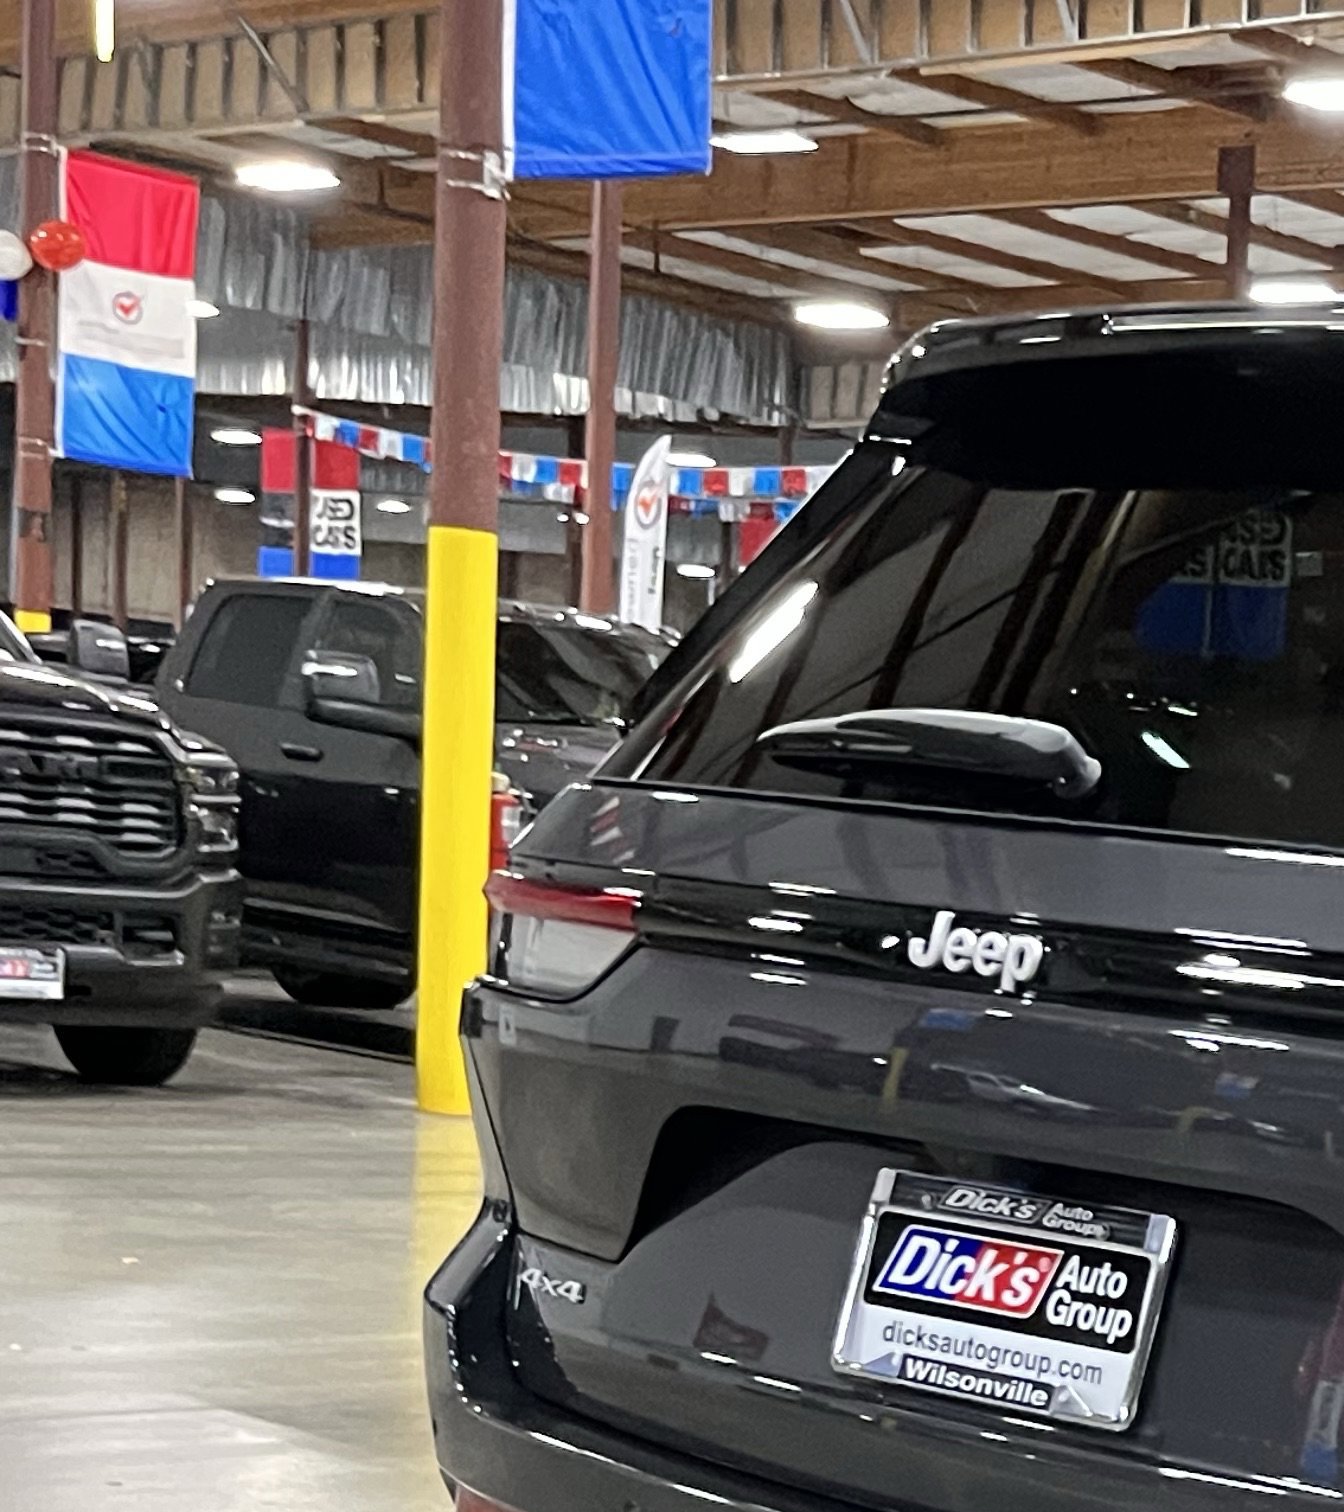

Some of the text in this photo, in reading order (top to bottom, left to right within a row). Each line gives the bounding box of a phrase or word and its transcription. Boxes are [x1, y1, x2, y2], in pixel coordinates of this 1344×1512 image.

[907, 910, 1044, 993] Jeep
[945, 1188, 1094, 1222] Dick's Auto
[888, 1234, 1129, 1308] Dick's Auto
[1046, 1291, 1133, 1344] Group
[882, 1320, 1103, 1384] dicksautogroup.com
[904, 1357, 1050, 1407] Wilsonville
